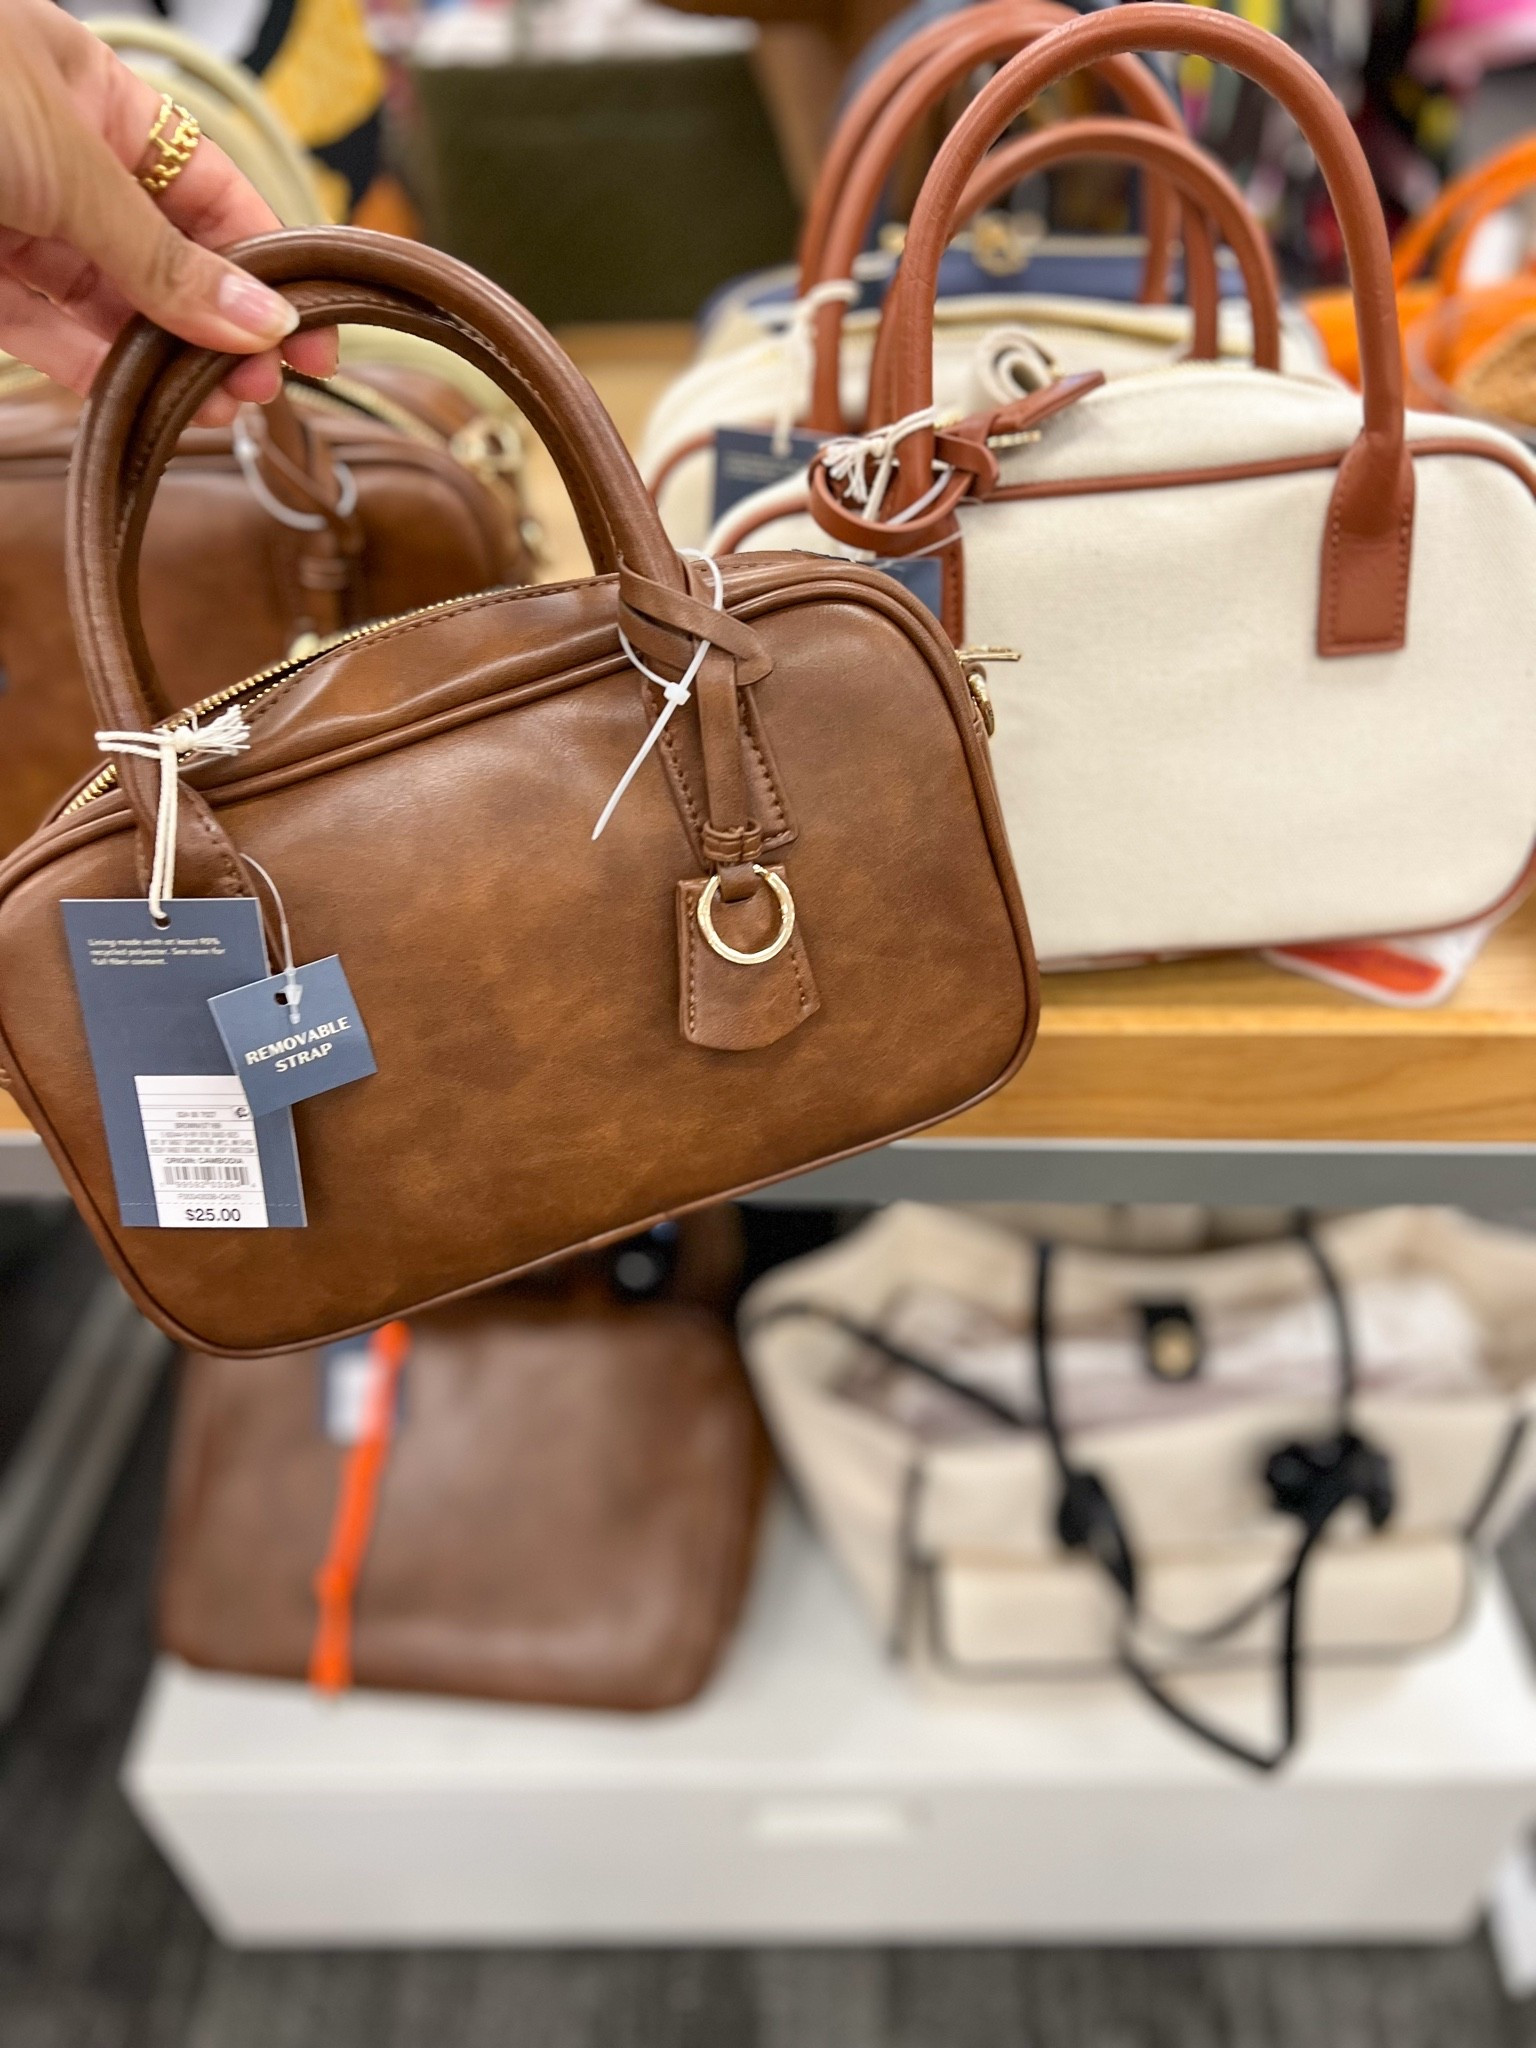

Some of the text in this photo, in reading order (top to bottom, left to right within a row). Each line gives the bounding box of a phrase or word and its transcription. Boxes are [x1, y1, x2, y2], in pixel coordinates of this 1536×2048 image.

[244, 1016, 352, 1065] REMOVABLE
[274, 1042, 333, 1073] STRAP
[198, 1157, 244, 1165] CAMBODIA
[185, 1208, 242, 1222] $25.00
